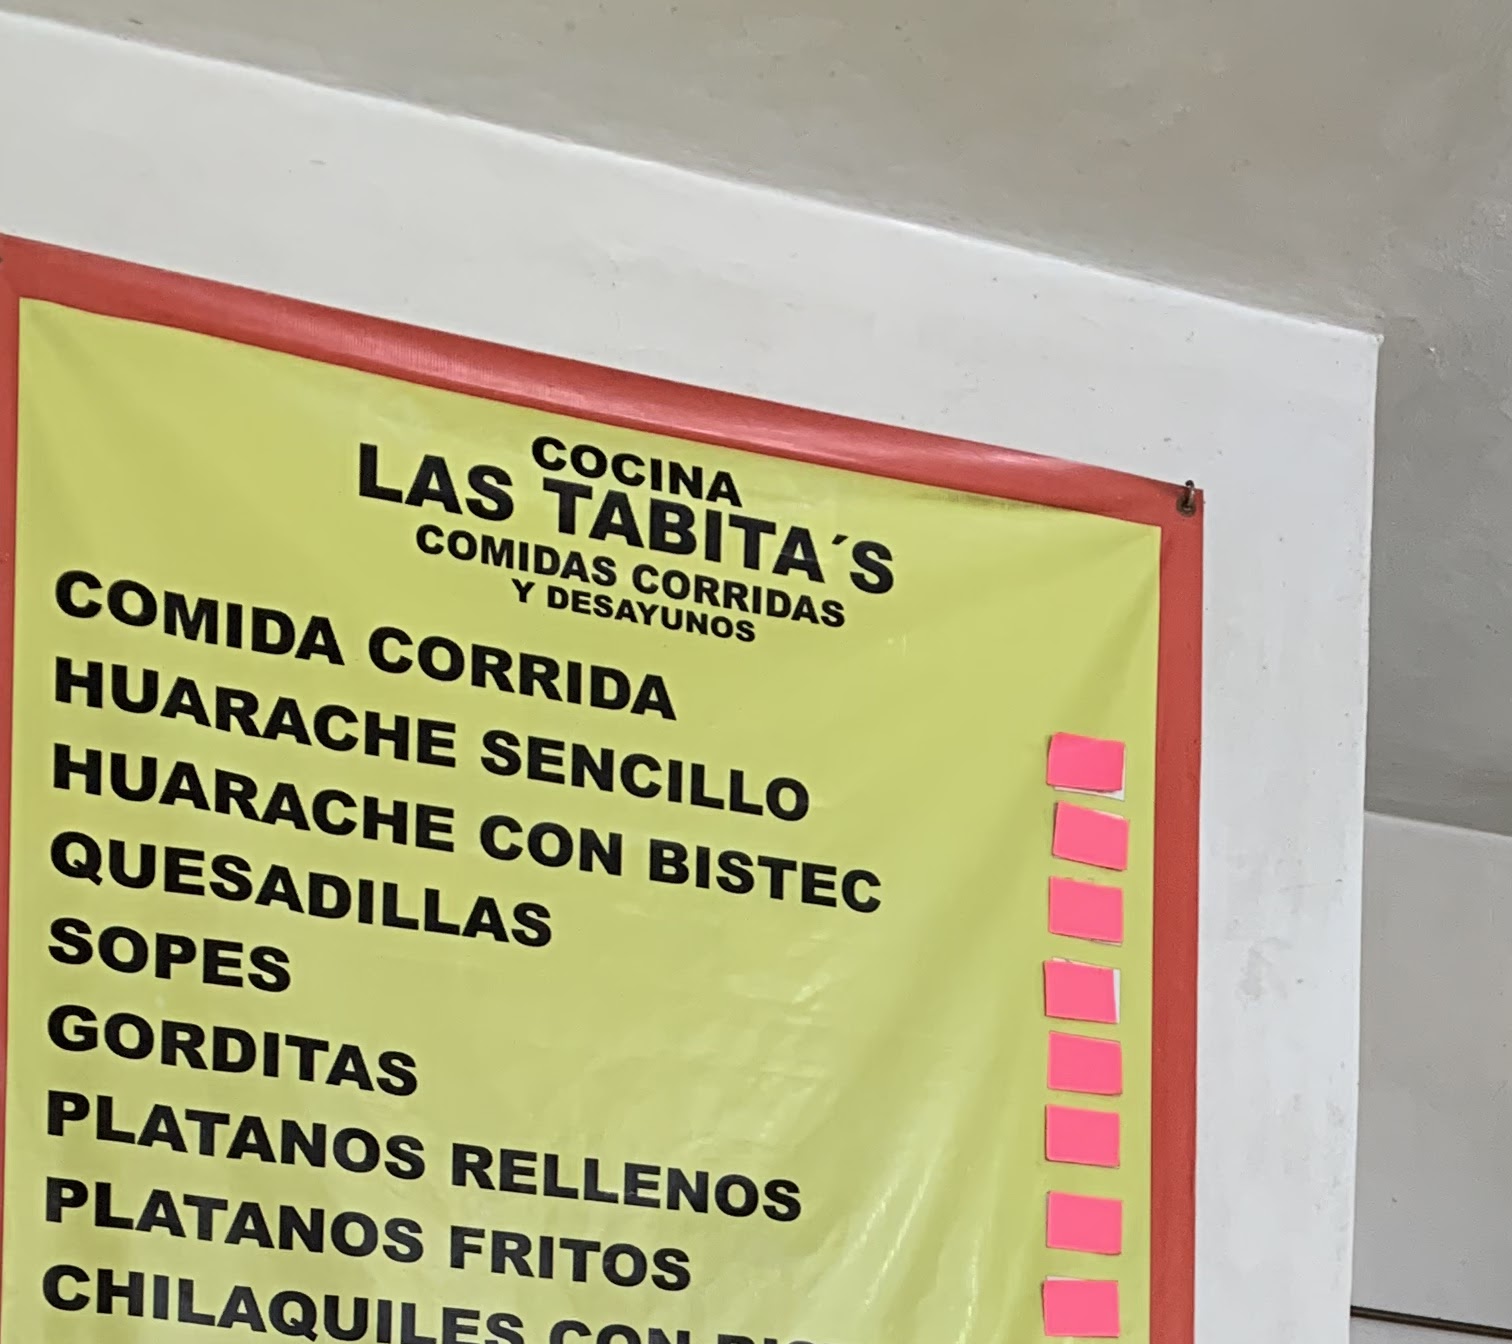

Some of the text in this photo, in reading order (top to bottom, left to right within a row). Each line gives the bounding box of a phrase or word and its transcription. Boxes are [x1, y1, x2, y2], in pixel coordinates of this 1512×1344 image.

[360, 443, 513, 521] LAS
[532, 437, 742, 507] COCINA
[417, 525, 845, 627] COMIDAS CORRIDAS
[512, 578, 756, 643] Y DESAYUNOS
[56, 570, 677, 721] COMIDA CORRIDA
[55, 656, 809, 822] HUARACHE SENCILLO
[53, 742, 882, 914] HUARACHE CON BISTEC
[50, 831, 552, 948] QUESADILLAS
[48, 917, 291, 993] SOPES
[47, 1004, 418, 1097] GORDITAS
[47, 1089, 802, 1222] PLATANOS RELLENOS
[45, 1176, 691, 1292] PLATANOS FRITOS
